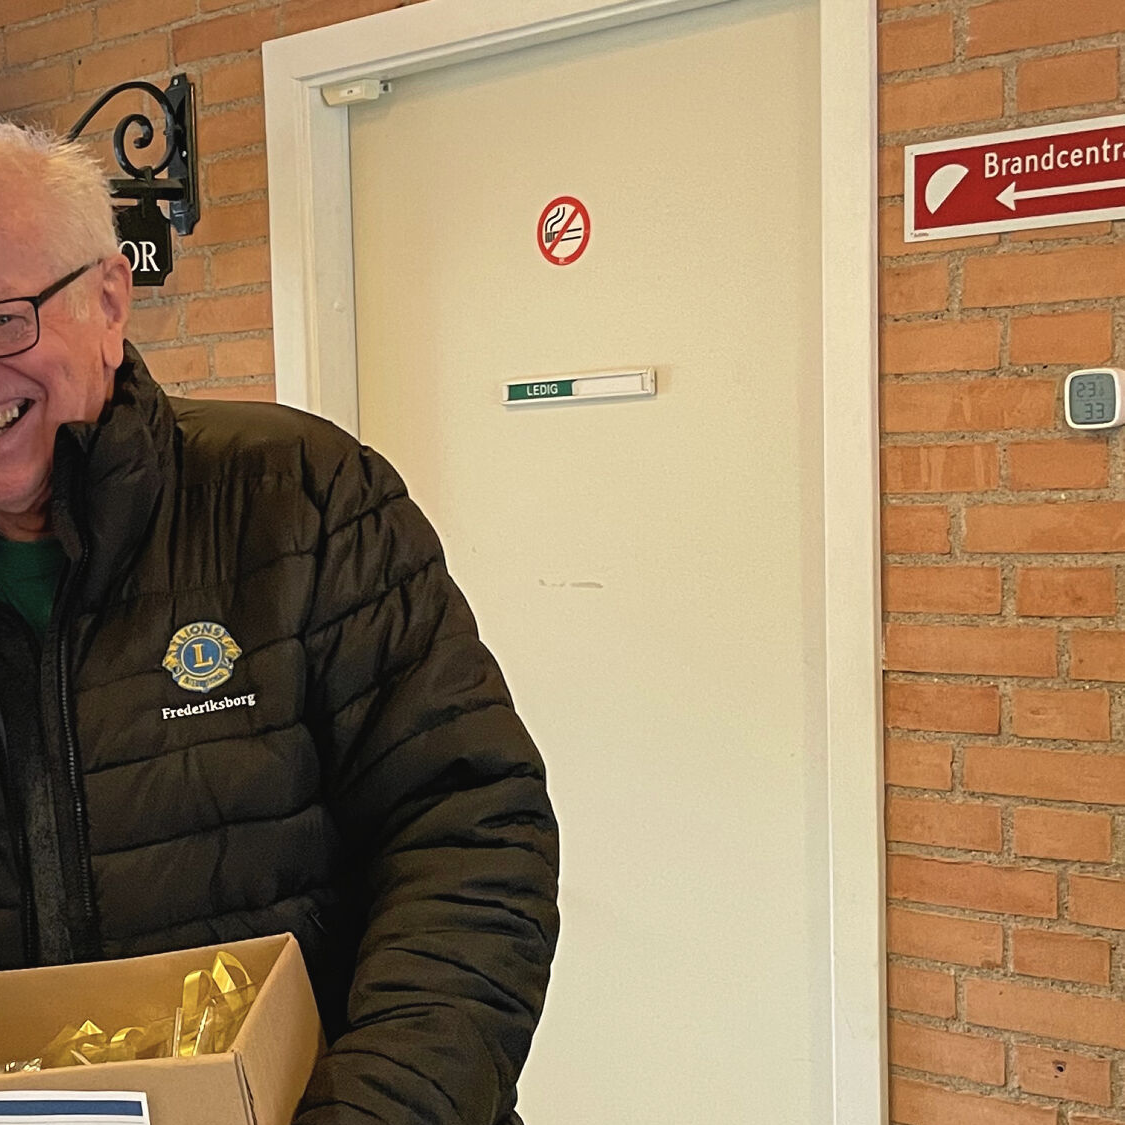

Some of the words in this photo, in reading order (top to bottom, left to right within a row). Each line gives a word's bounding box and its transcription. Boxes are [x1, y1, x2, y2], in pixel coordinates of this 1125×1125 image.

[118, 240, 161, 272] OR
[526, 383, 559, 397] LEDIG
[176, 623, 222, 641] LIONS
[192, 643, 214, 668] L
[161, 693, 256, 720] Frederiksborg
